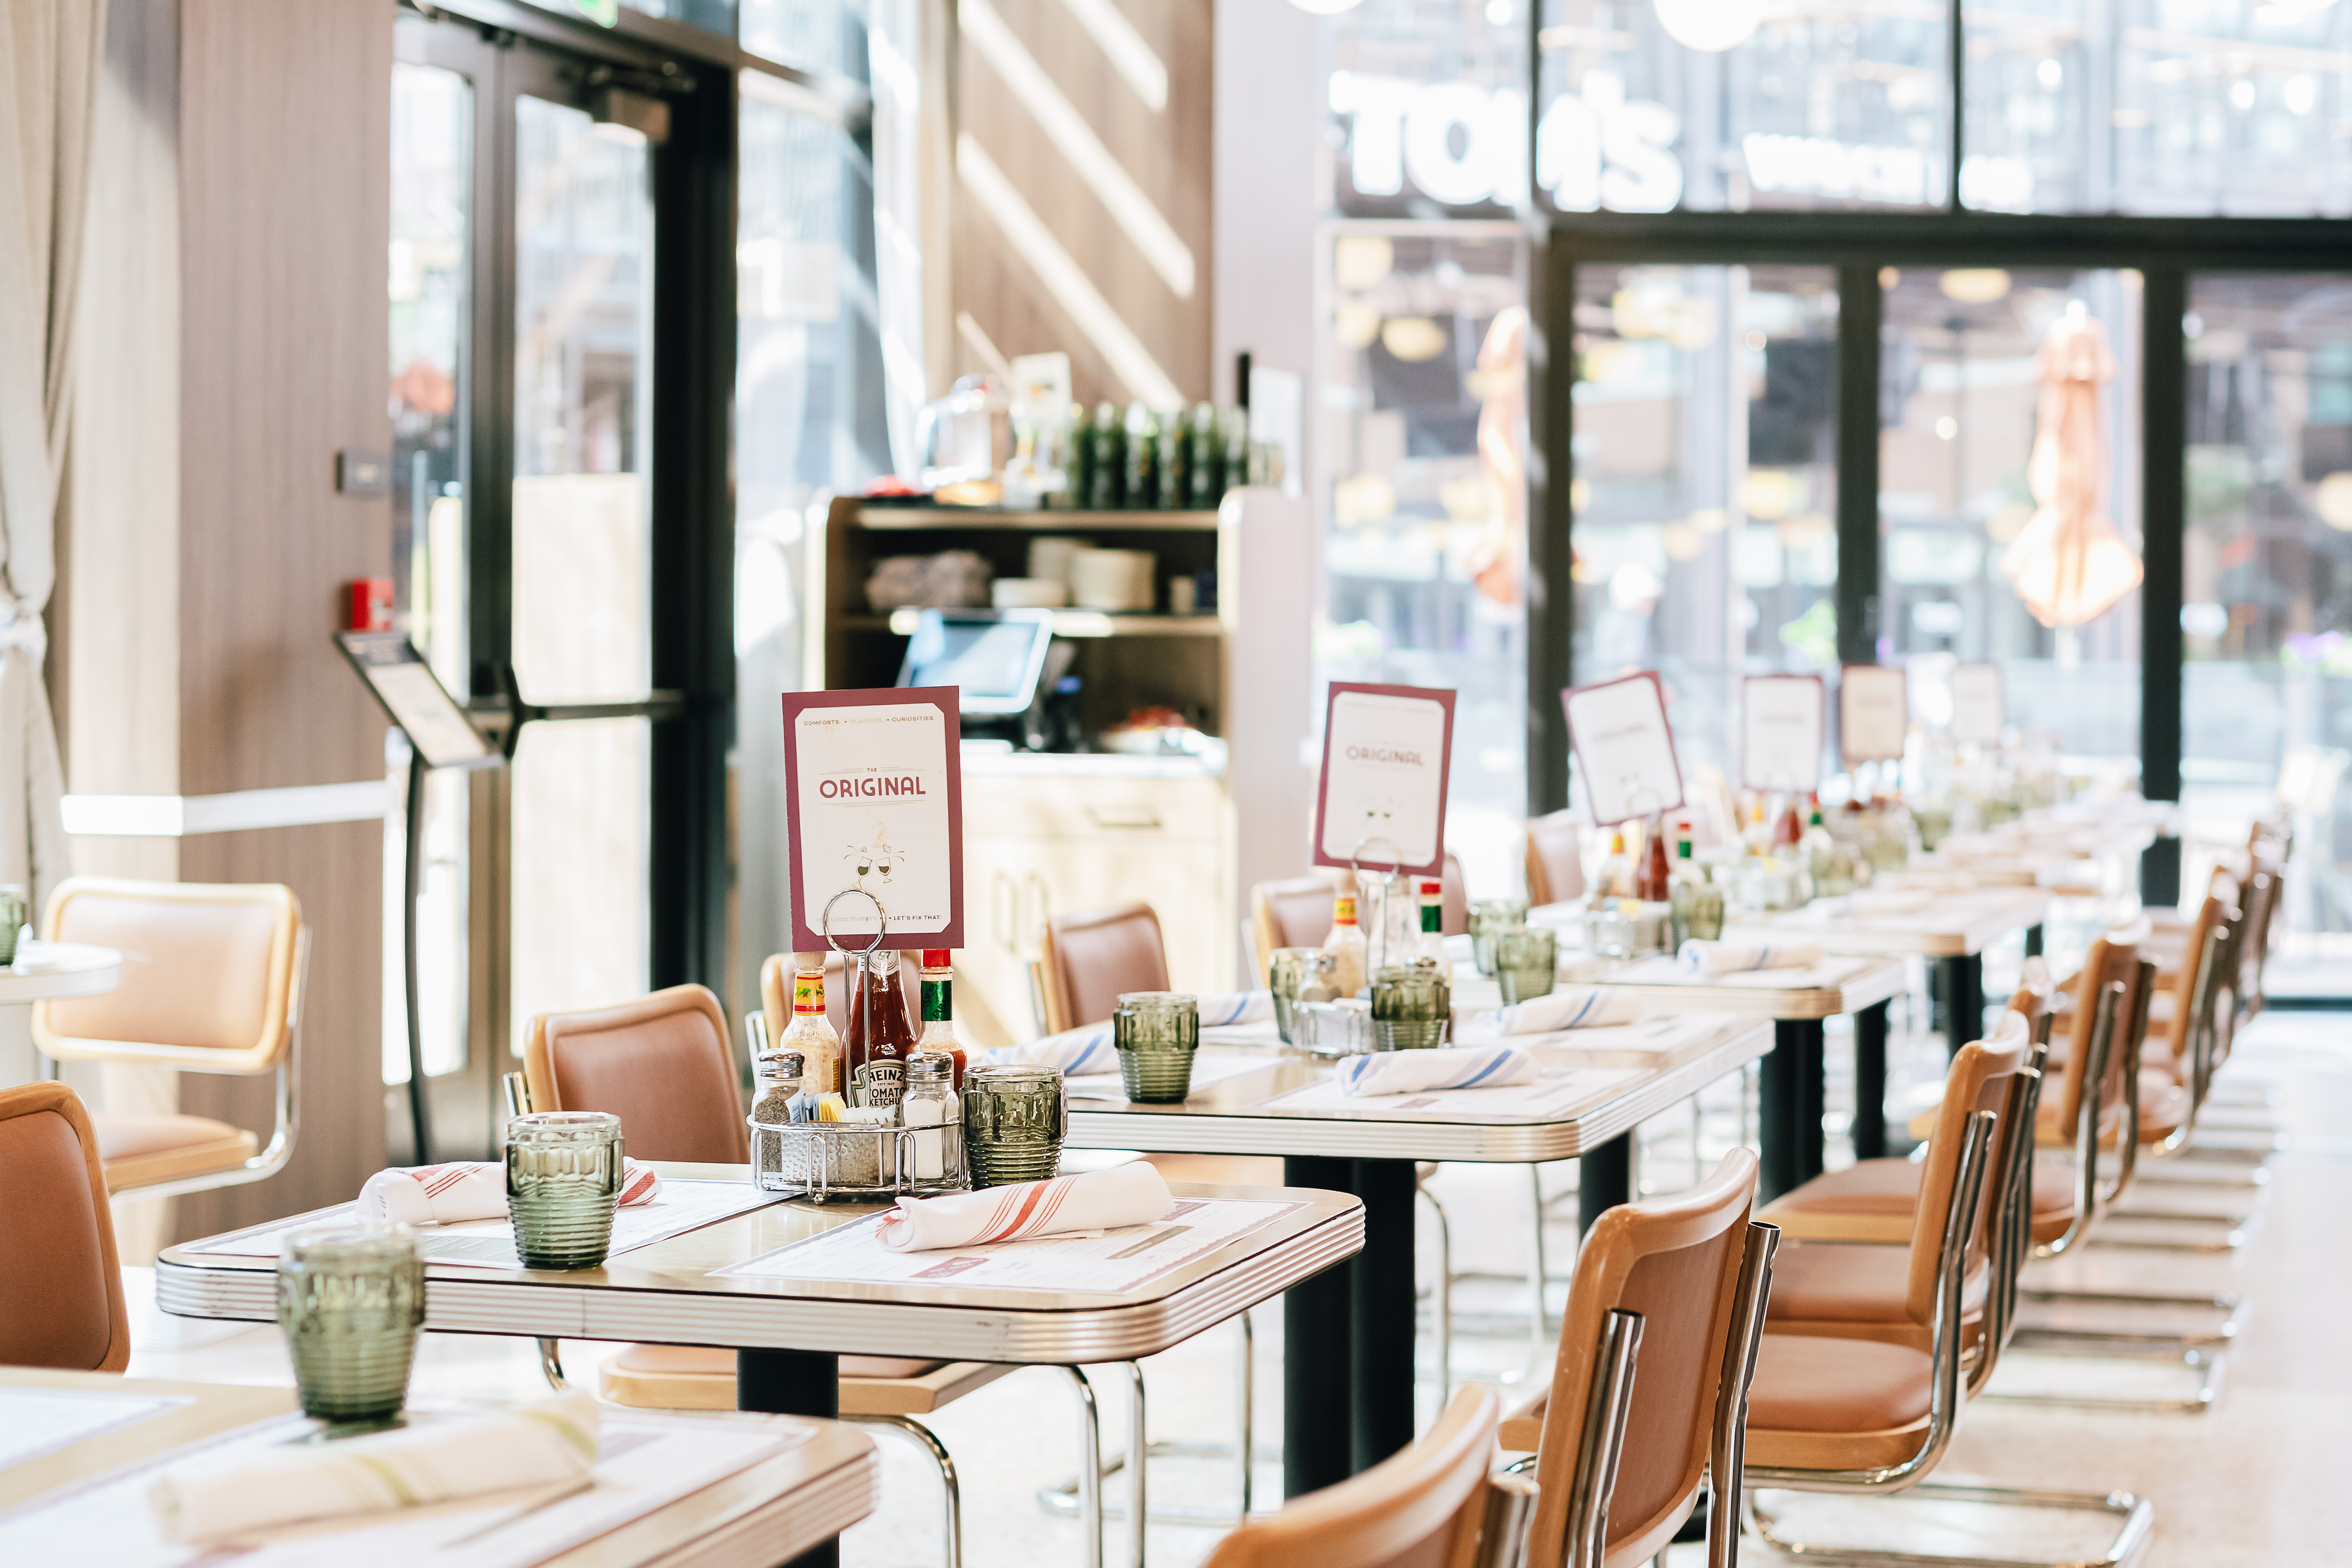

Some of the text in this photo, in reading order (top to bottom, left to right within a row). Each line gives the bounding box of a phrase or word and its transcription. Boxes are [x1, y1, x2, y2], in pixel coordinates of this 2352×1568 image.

[1346, 745, 1423, 766] ORIGINAL
[820, 776, 926, 799] ORIGINAL
[870, 1086, 905, 1098] OMATO
